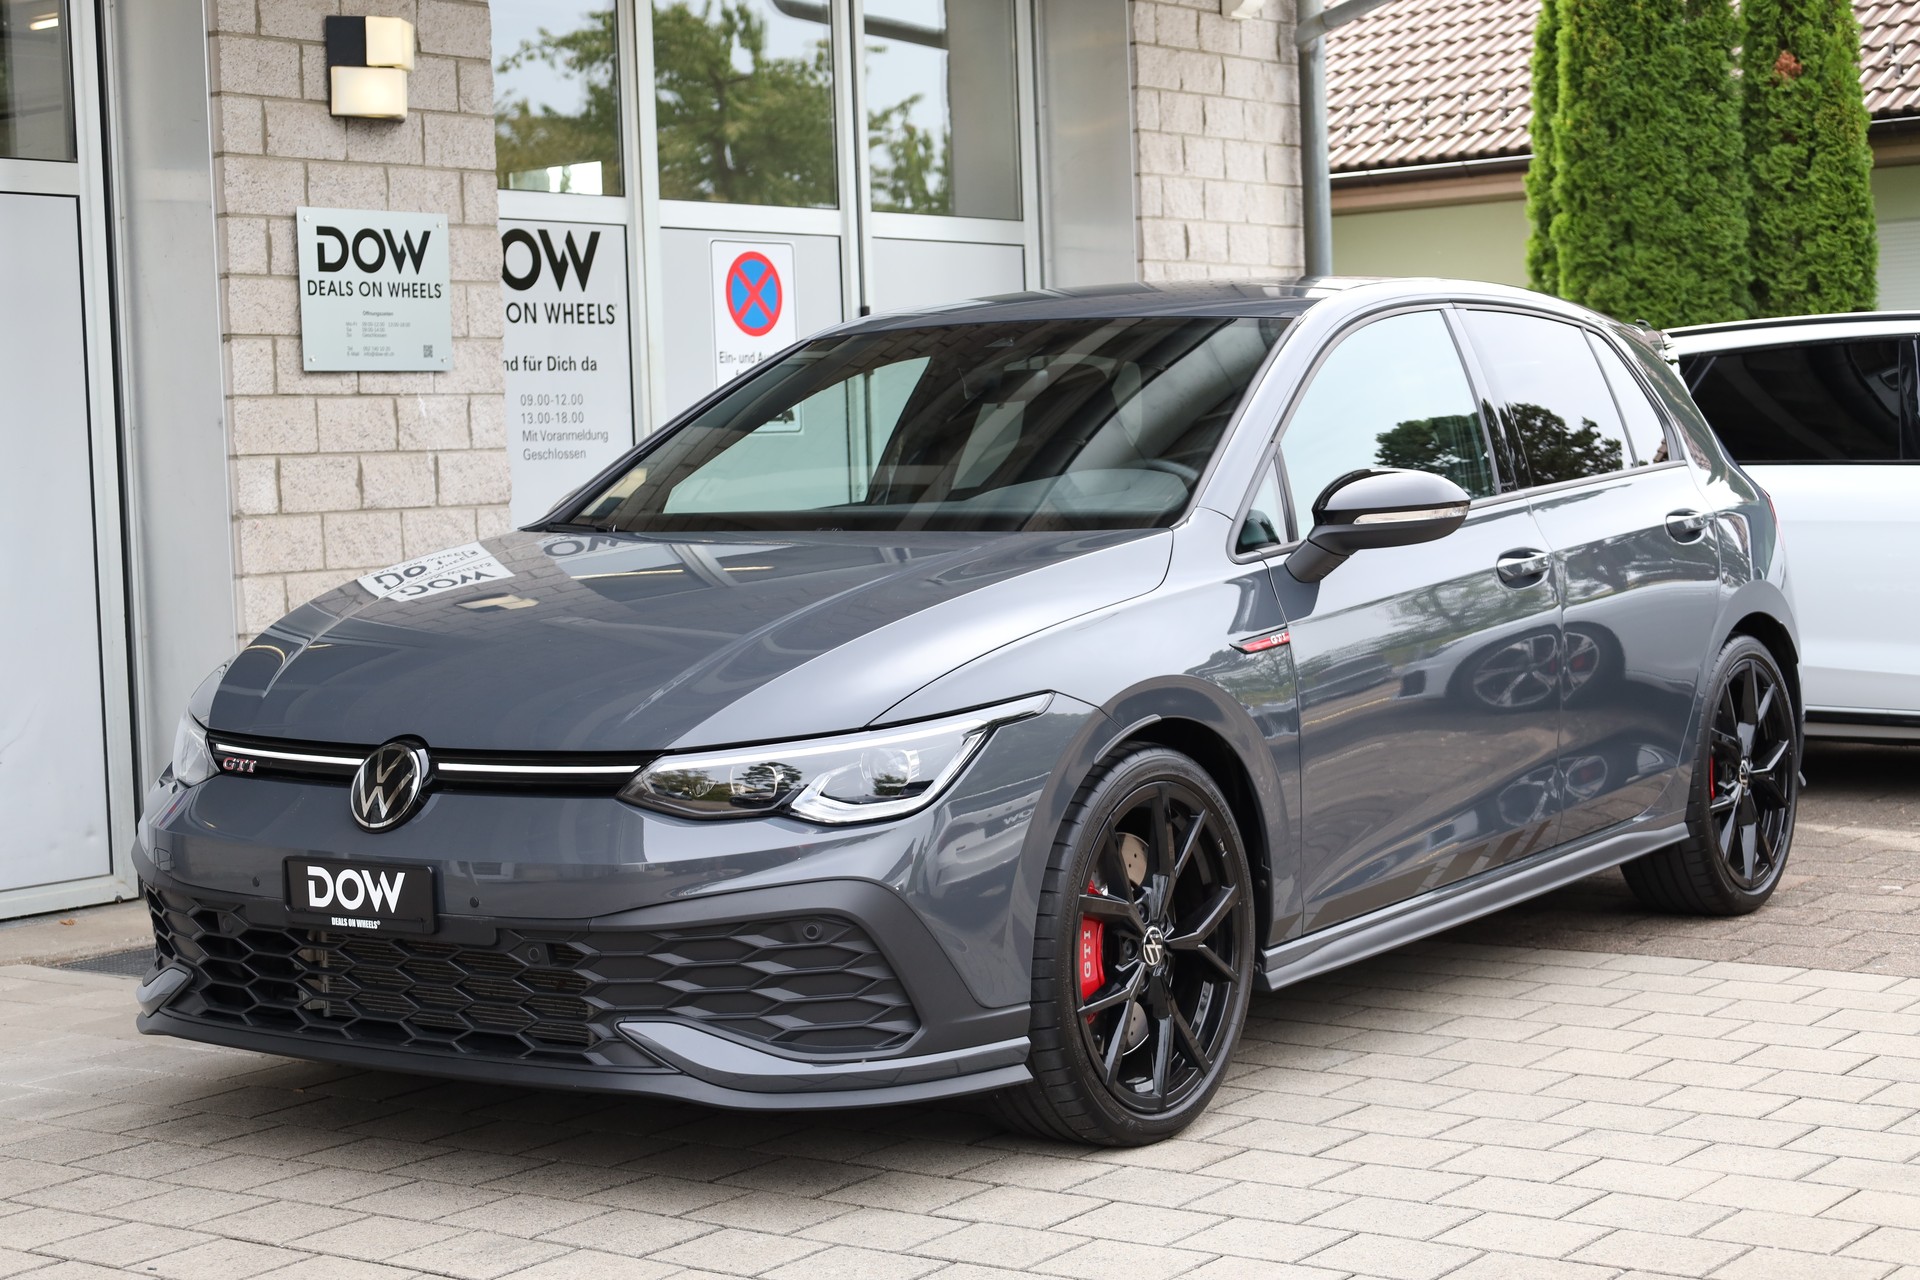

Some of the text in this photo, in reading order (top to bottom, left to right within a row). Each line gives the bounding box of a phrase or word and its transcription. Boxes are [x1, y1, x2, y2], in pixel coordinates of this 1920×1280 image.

[316, 225, 431, 275] DOW
[501, 228, 601, 292] OW
[307, 280, 353, 297] DEALS
[358, 281, 383, 298] ON
[505, 302, 537, 324] ON
[523, 355, 542, 372] für
[547, 355, 577, 372] Dich
[581, 355, 598, 372] da
[719, 351, 737, 364] Ein-
[739, 352, 756, 364] und
[520, 393, 584, 407] 09.00-12.00
[521, 411, 585, 425] 13.00-18.00
[522, 428, 609, 444] Mit Voranmeldung
[523, 448, 587, 461] Geschlossen
[1270, 632, 1288, 645] GTI
[222, 756, 257, 773] GTI
[307, 865, 406, 914] DOW
[331, 917, 348, 927] DEALS
[348, 918, 357, 928] ON
[1083, 930, 1092, 978] GTI
